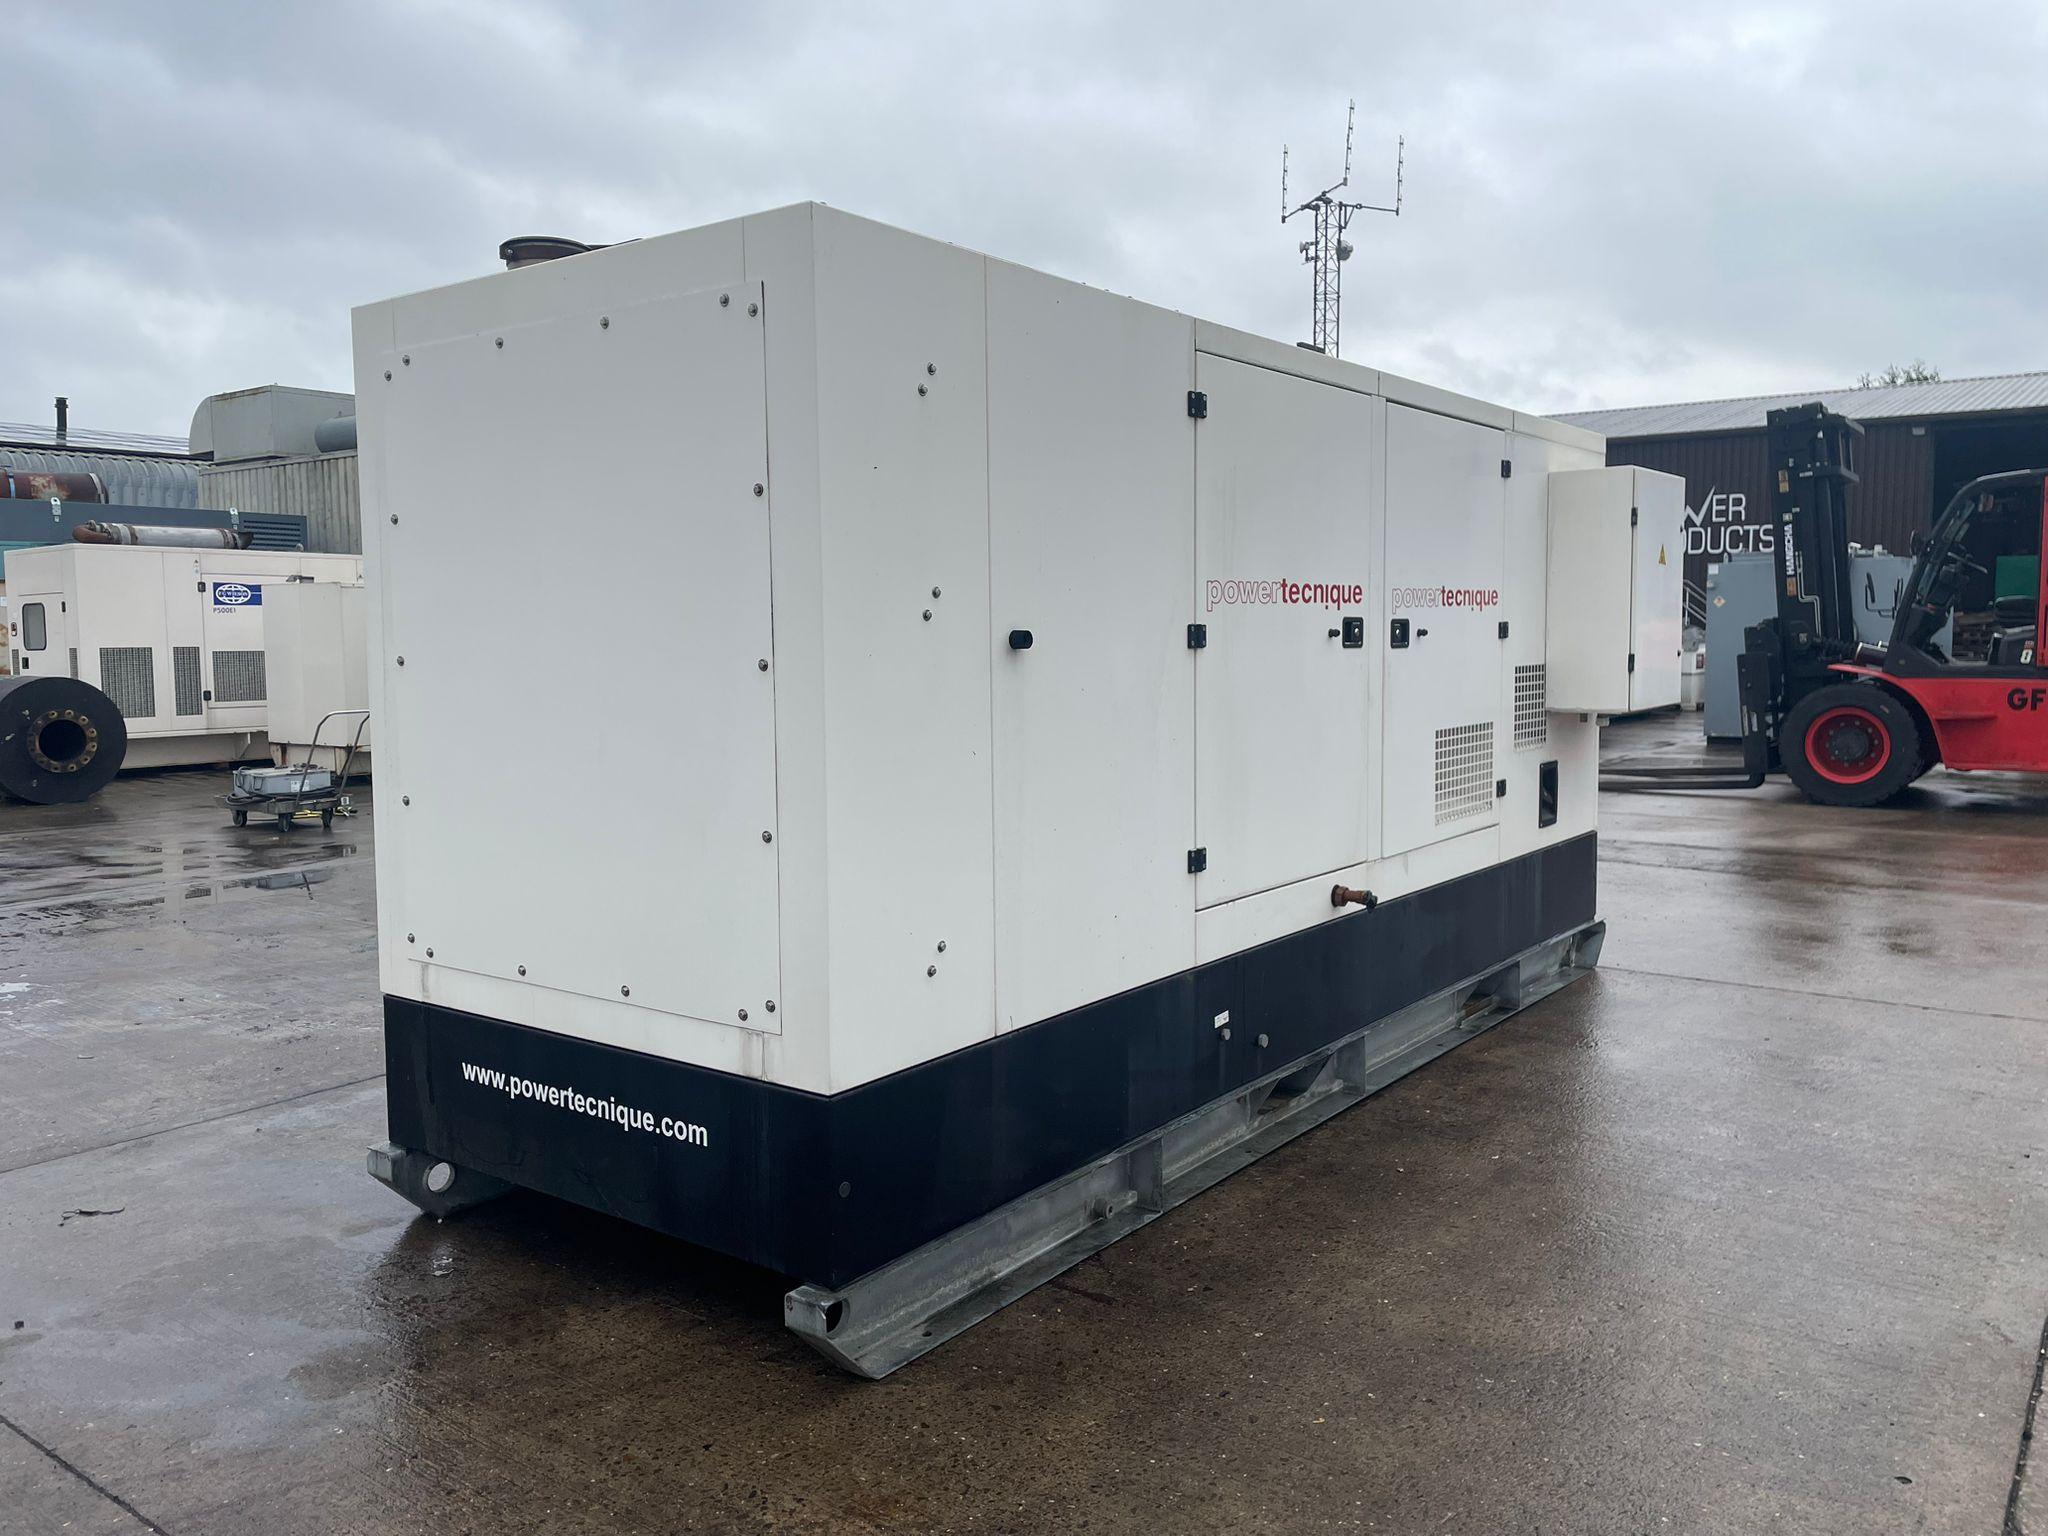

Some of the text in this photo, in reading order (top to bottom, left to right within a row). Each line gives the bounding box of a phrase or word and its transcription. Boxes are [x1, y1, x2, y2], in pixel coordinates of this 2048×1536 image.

[1683, 524, 1775, 555] DUCTS
[1206, 578, 1363, 612] powertecnique
[1391, 586, 1499, 614] powertecnique
[461, 1062, 708, 1147] www.powertecnique.com
